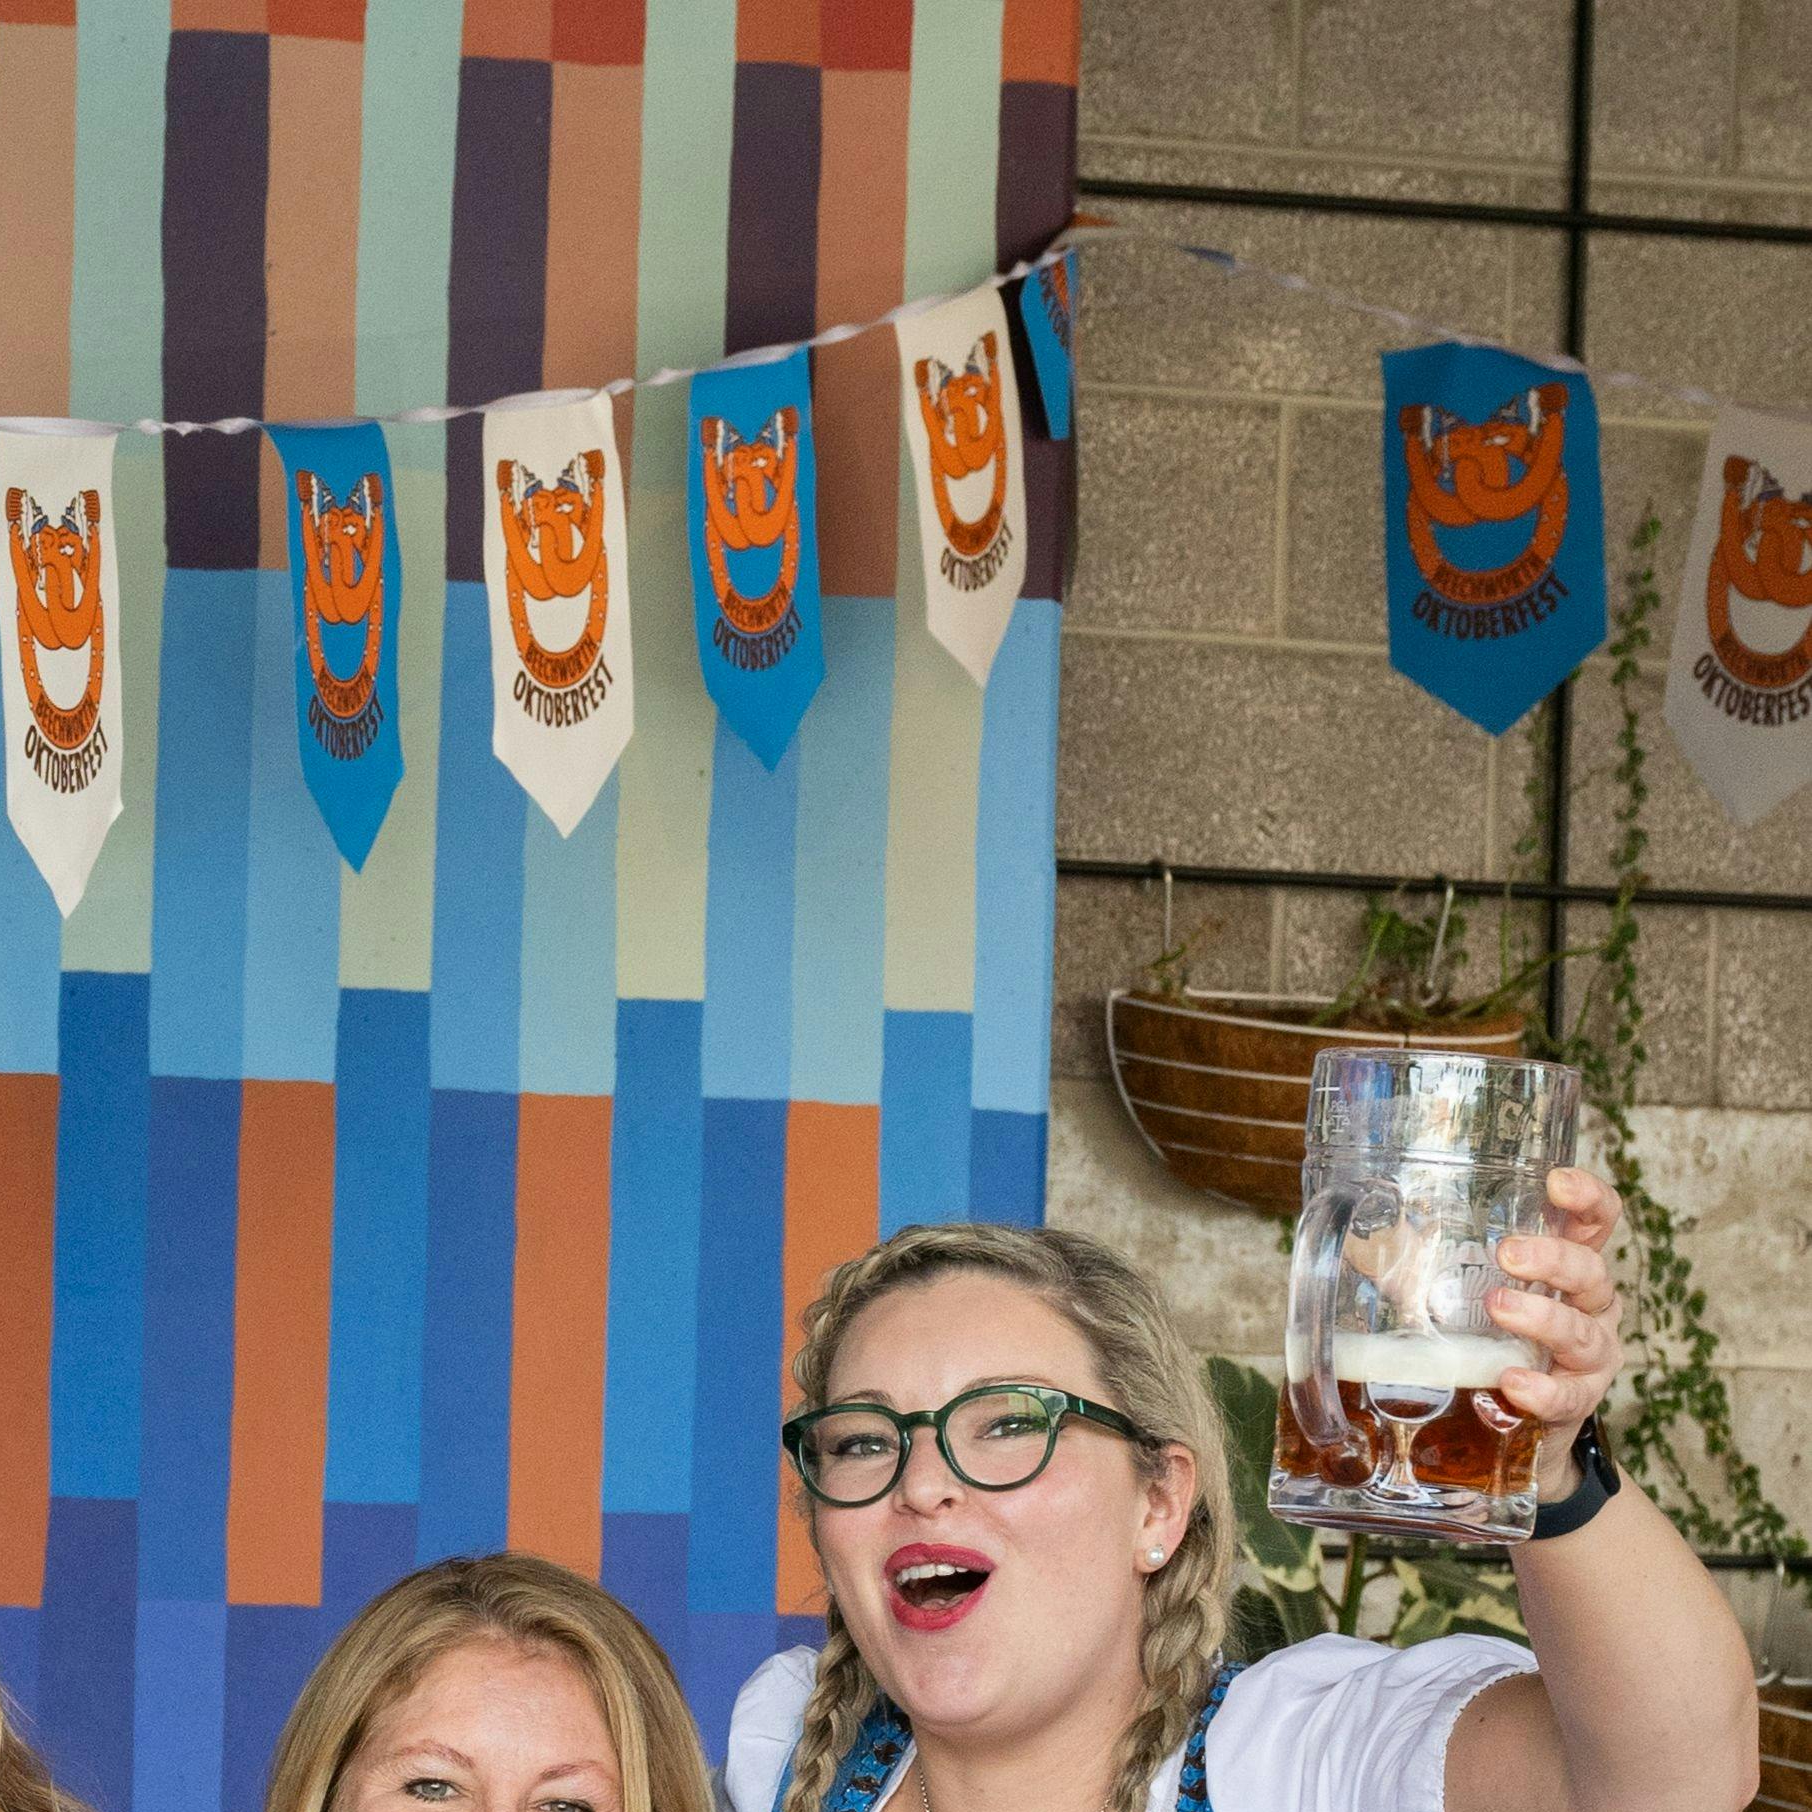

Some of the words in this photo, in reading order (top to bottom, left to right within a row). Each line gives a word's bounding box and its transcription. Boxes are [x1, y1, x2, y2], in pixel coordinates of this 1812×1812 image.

[1413, 569, 1570, 640] OKTOBERFEST
[513, 653, 614, 729] OKTOBERFEST
[1694, 653, 1812, 726] OKTOBERFES
[25, 717, 108, 794] OKTOBERFEST
